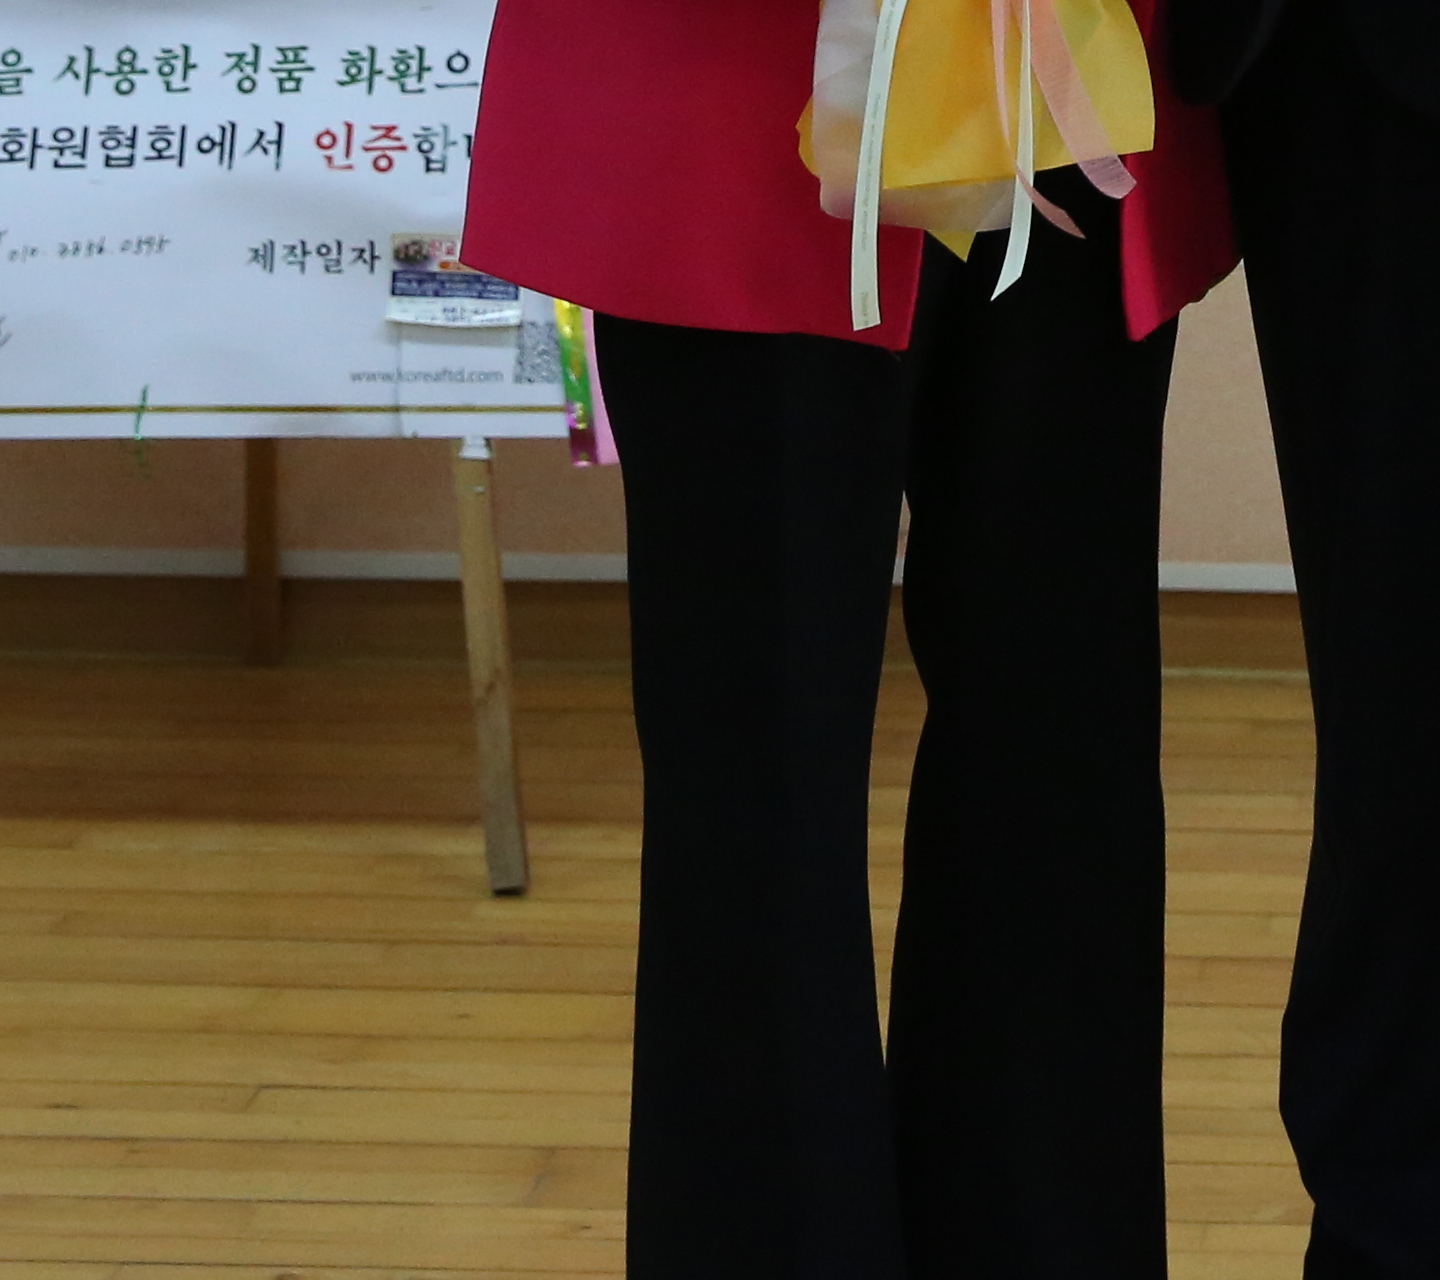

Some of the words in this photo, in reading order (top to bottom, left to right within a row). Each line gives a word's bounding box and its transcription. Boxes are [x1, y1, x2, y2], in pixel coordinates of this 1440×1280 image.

[54, 44, 197, 96] 사용한
[224, 42, 316, 96] 정품
[336, 43, 480, 96] 화환으
[315, 120, 473, 175] 인증합
[247, 239, 382, 275] 제작일자
